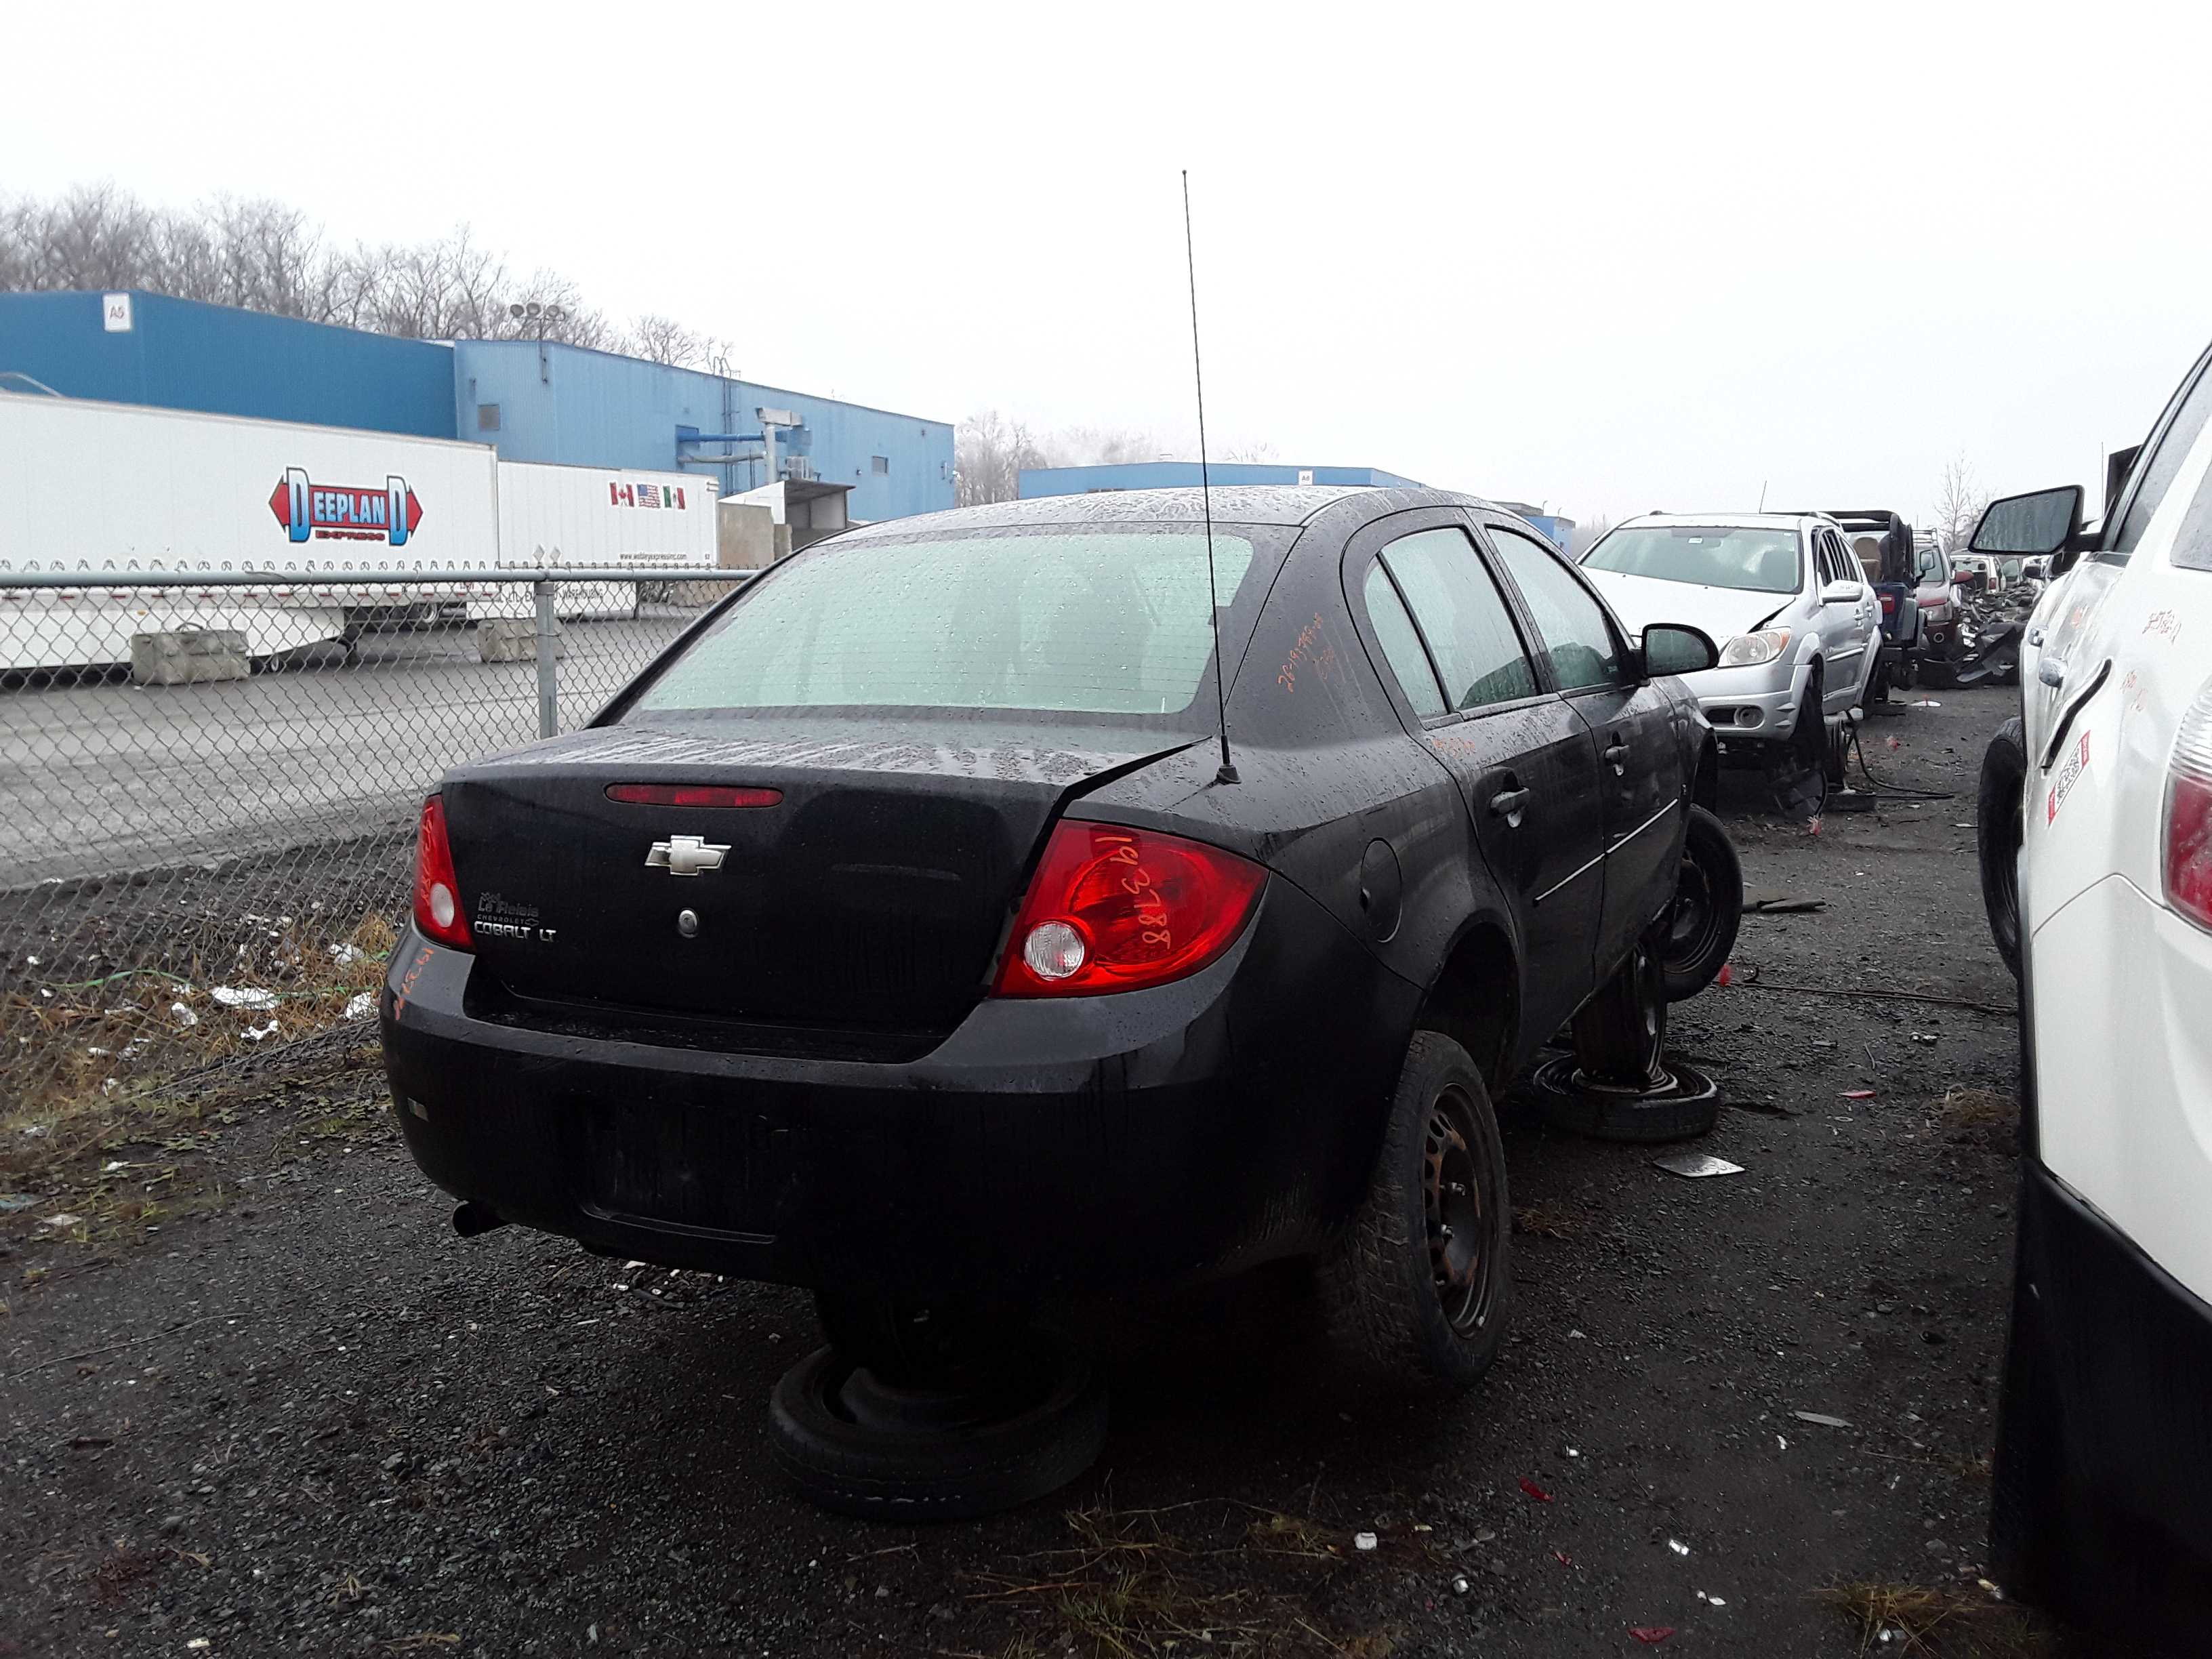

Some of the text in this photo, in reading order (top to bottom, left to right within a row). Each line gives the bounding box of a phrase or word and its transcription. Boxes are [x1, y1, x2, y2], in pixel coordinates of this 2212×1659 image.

[109, 305, 125, 320] A5
[287, 466, 409, 546] DEEPLAND
[1094, 836, 1171, 949] 193788
[477, 914, 525, 924] CHEVROLET
[474, 920, 557, 943] COBALT LT
